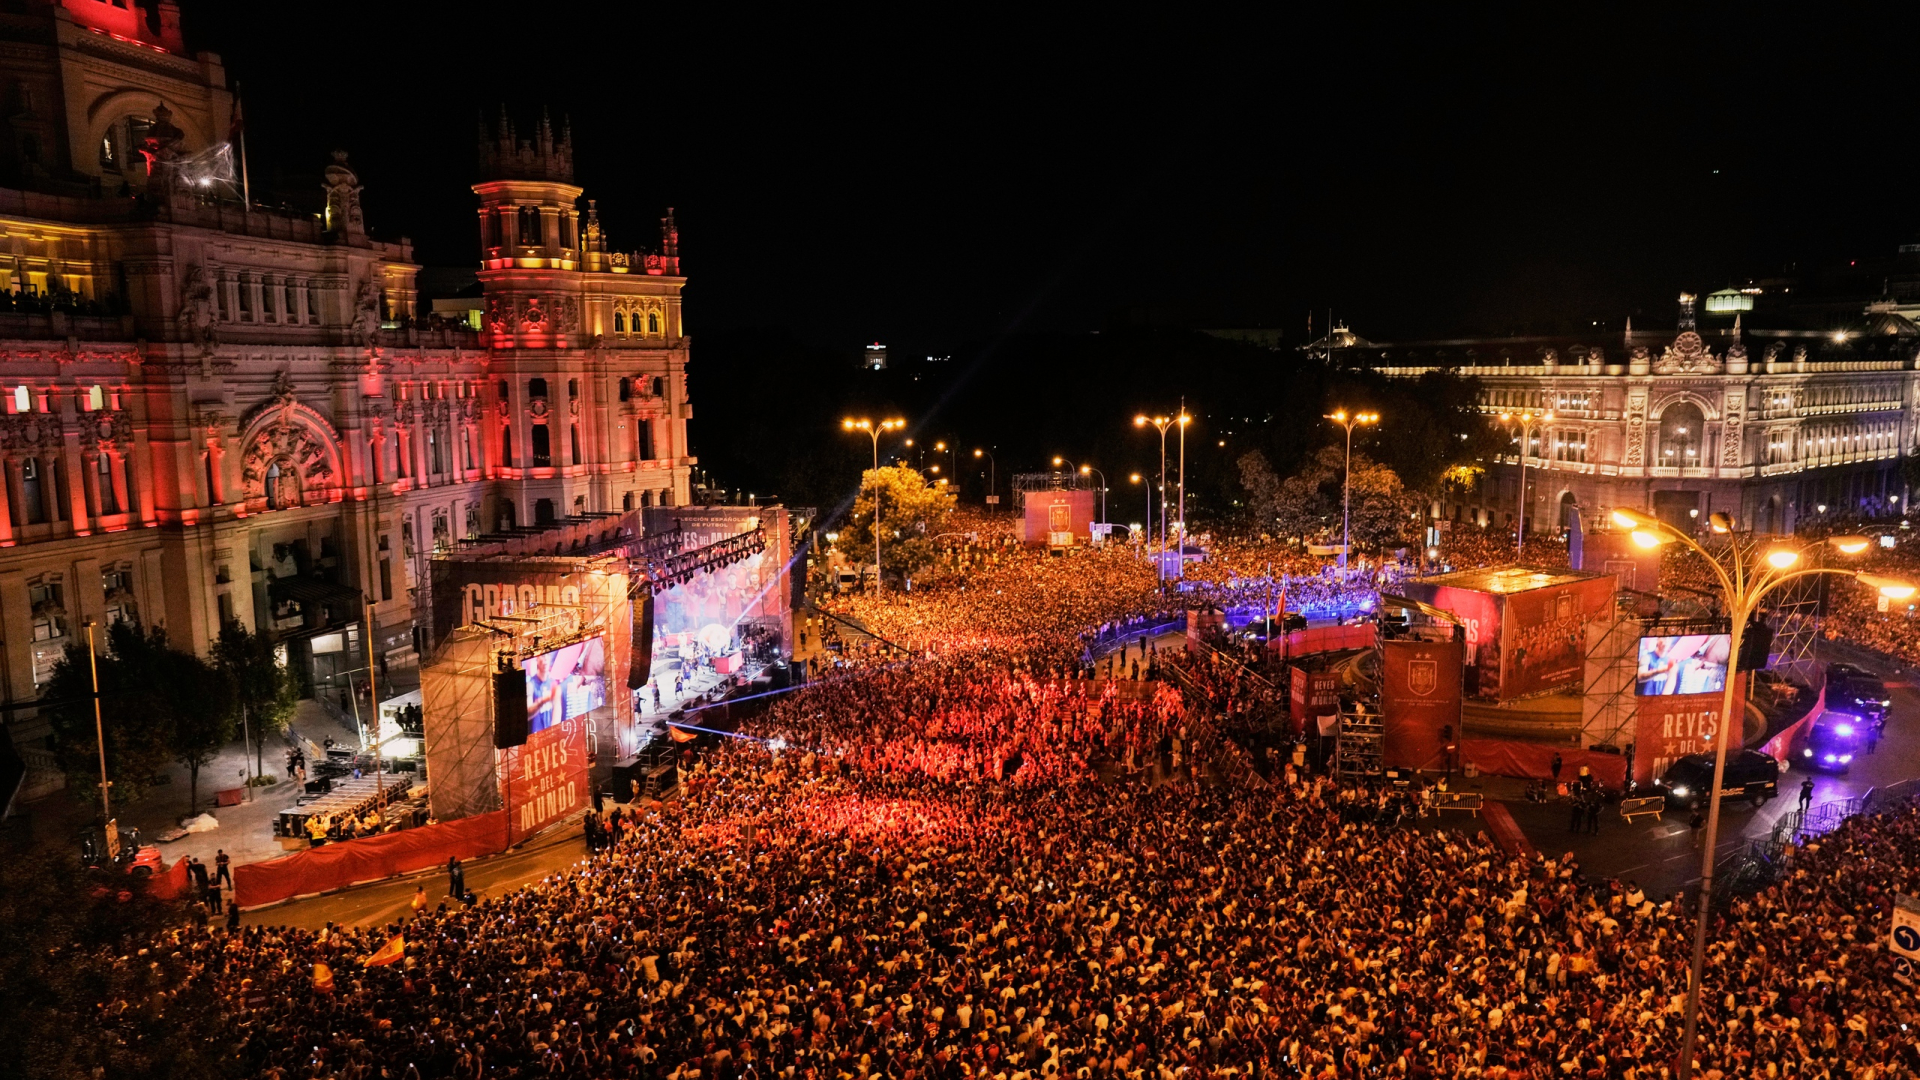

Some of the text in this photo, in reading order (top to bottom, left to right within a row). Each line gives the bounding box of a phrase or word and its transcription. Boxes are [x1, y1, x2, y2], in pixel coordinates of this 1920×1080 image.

[700, 536, 710, 546] DEL
[1314, 680, 1335, 690] REYES
[1311, 695, 1338, 706] MUNDO
[1663, 712, 1718, 738] REYES
[1680, 740, 1697, 754] DEL
[524, 738, 568, 781] REYES
[540, 774, 554, 792] DEL
[521, 781, 576, 832] MUNDO
